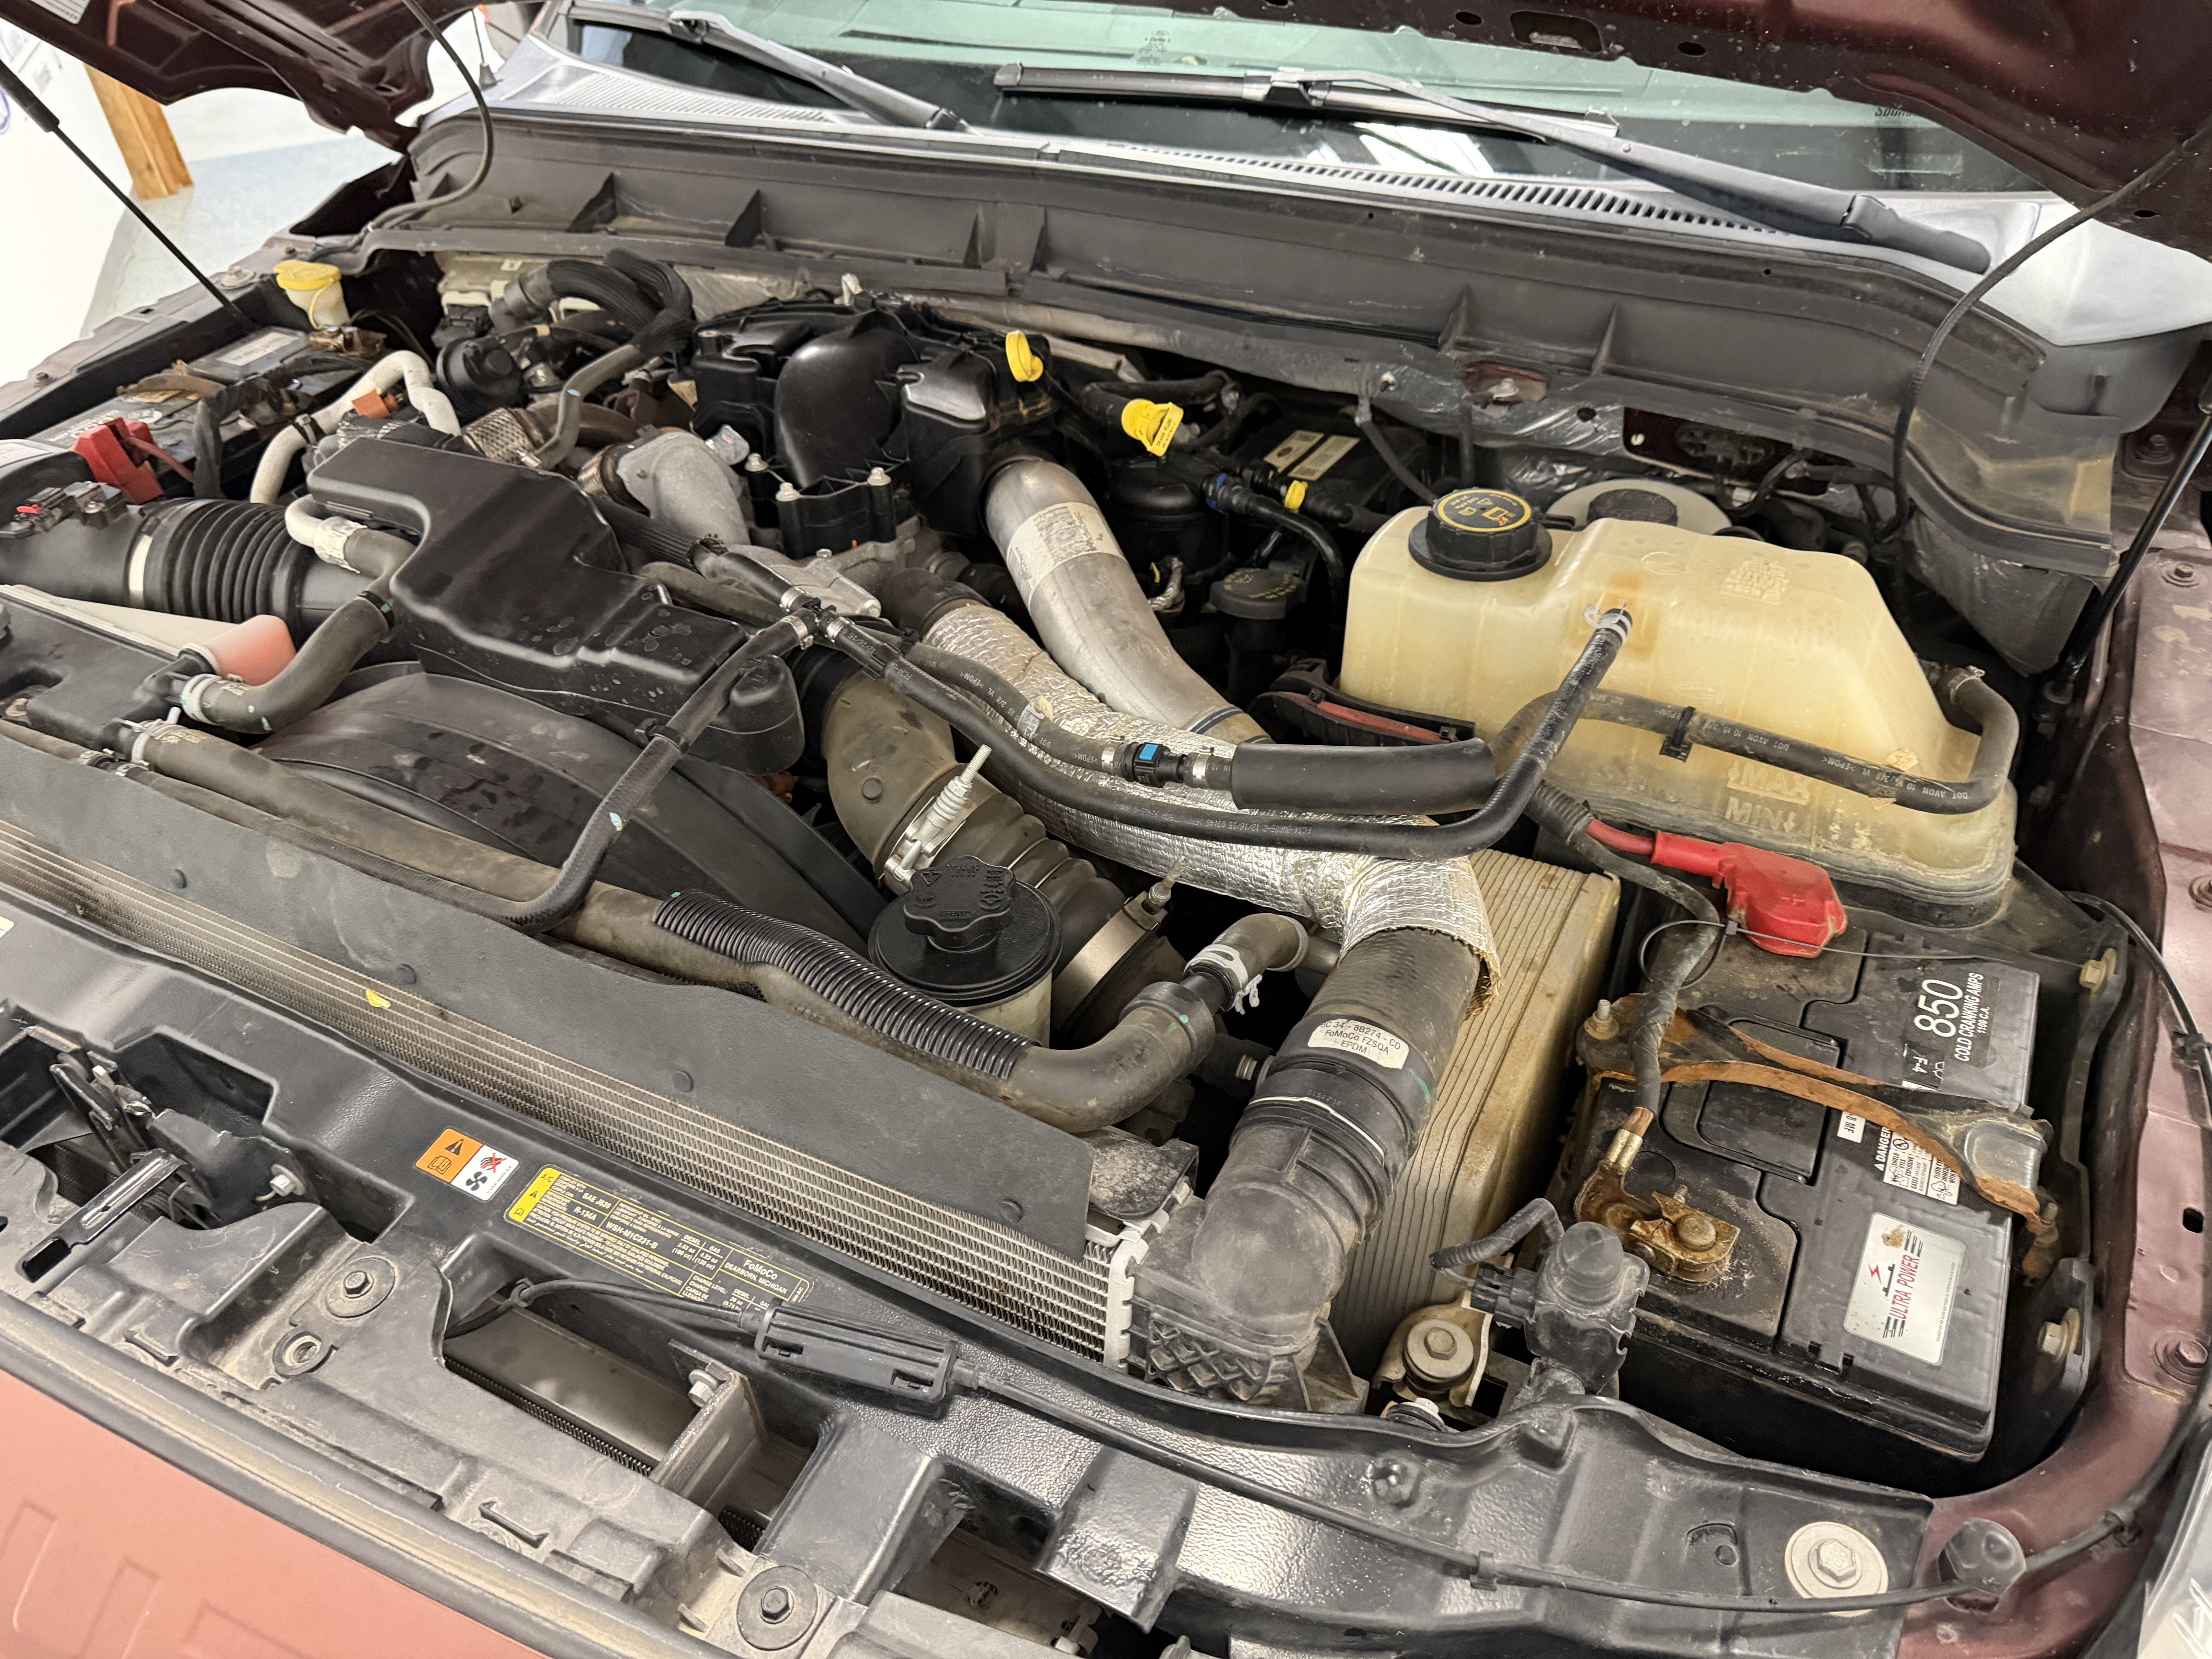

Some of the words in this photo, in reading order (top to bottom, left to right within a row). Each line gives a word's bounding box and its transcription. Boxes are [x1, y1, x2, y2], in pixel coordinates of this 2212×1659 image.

[960, 670, 985, 689] >EPDM<
[996, 696, 1007, 708] 3/8
[1039, 737, 1051, 748] DOT
[1747, 733, 1769, 745] AVON
[1772, 741, 1789, 751] DOT
[1742, 763, 1812, 800] MAX
[1922, 786, 1946, 798] AVON
[1951, 790, 1969, 801] DOT
[1726, 797, 1782, 831] MIN
[1966, 972, 1985, 997] AMPS
[1914, 979, 1967, 1037] 850
[1955, 995, 1980, 1037] CRANKING
[1979, 1007, 1990, 1019] C.A.
[1976, 1019, 1988, 1033] 1100
[1324, 1025, 1360, 1045] FoMoCo
[1360, 1036, 1391, 1054] FZSQA
[1353, 1024, 1381, 1039] 8B274
[1389, 1039, 1401, 1050] CD
[1341, 1040, 1367, 1053] EPDM
[1954, 1037, 1972, 1061] COLD
[1843, 1121, 1856, 1133] MF
[1874, 1126, 1893, 1162] DANGER
[1891, 1152, 1899, 1166] SHIELD
[1904, 1156, 1914, 1176] EXPLOSIVE
[540, 1174, 554, 1182] A/C
[1934, 1166, 1942, 1179] FLUSH
[1948, 1173, 1957, 1183] WITH
[1910, 1176, 1918, 1189] GASES
[582, 1192, 598, 1203] SAE
[595, 1199, 611, 1209] J639
[573, 1206, 597, 1221] R-134A
[606, 1221, 658, 1249] WSH-M1C231-B
[683, 1234, 701, 1245] DIESEL
[709, 1245, 721, 1254] GAS
[743, 1259, 778, 1280] FoMoCo
[1897, 1254, 1921, 1286] POWER
[693, 1275, 713, 1287] CHARGE
[711, 1284, 728, 1294] LEVEL:
[724, 1262, 758, 1282] DEARBORN,
[758, 1277, 788, 1294] MICHIGAN
[685, 1286, 702, 1297] CARGA
[689, 1281, 709, 1293] CHARGE:
[733, 1288, 749, 1299] DIESEL
[1888, 1289, 1909, 1320] ULTRA
